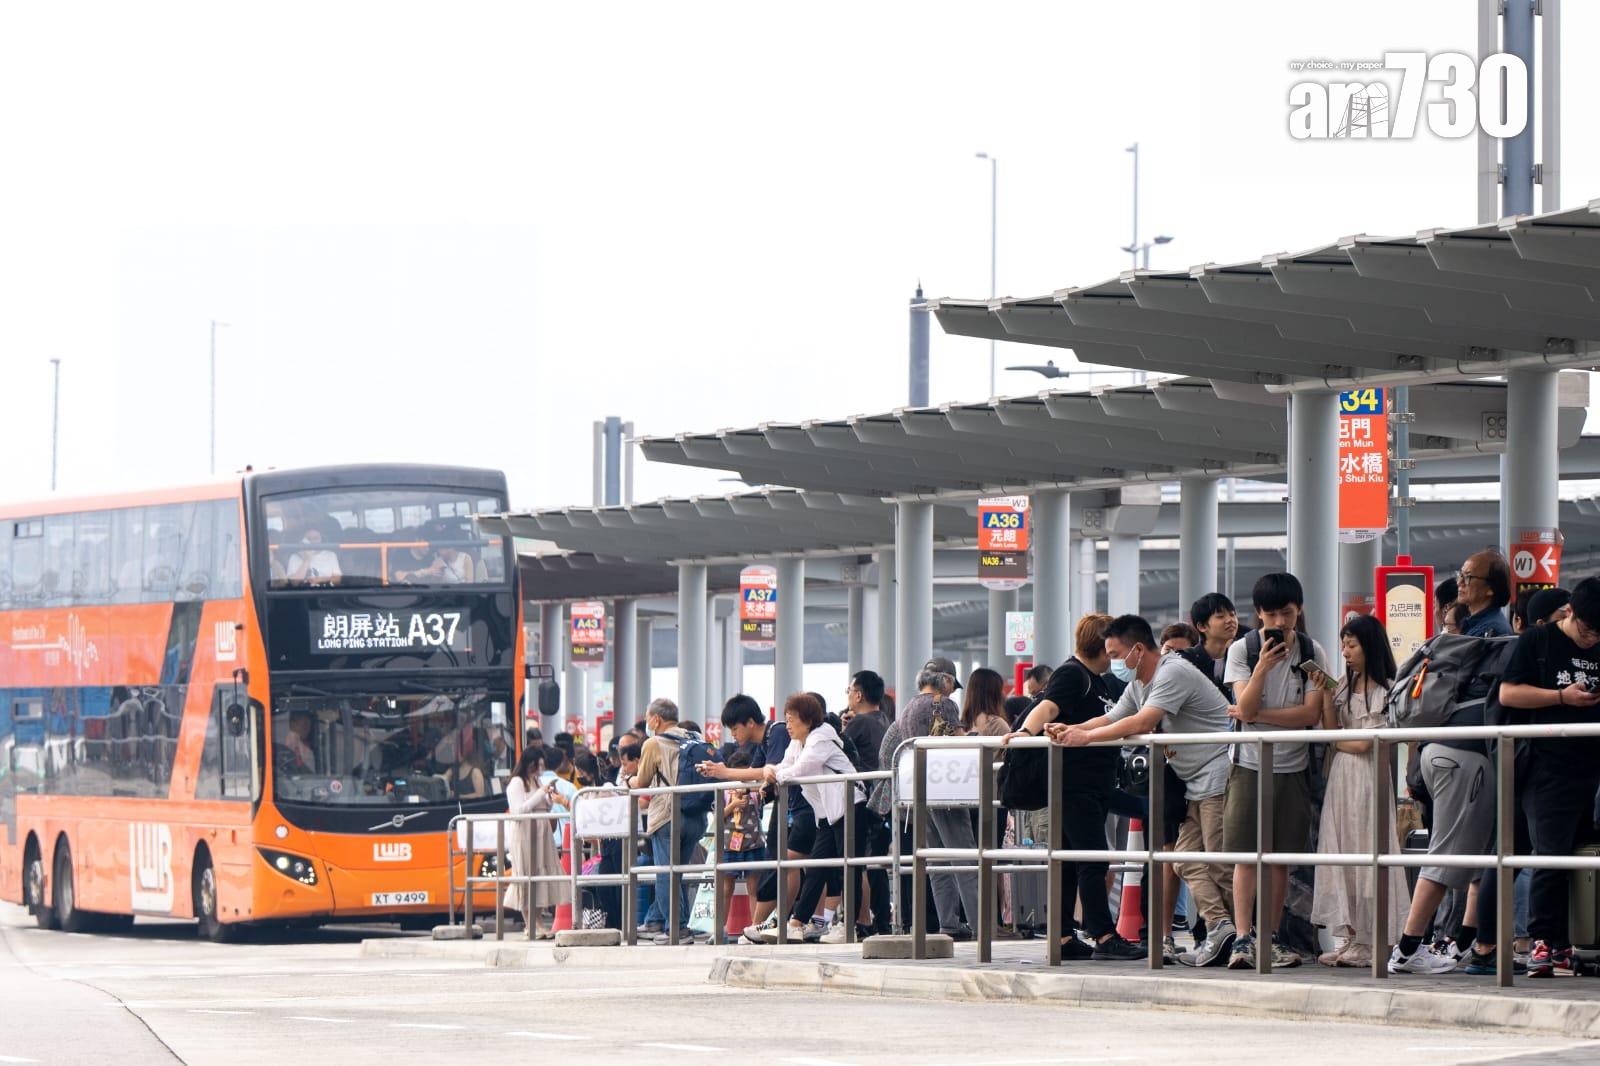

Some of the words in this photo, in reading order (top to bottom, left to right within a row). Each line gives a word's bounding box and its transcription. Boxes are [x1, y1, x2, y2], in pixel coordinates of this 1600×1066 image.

[1339, 388, 1378, 412] 34
[1339, 440, 1351, 448] en
[1353, 440, 1374, 448] Mun
[1341, 453, 1383, 474] 水橋
[1345, 474, 1366, 483] Shui
[1368, 474, 1384, 483] Kiu
[1012, 498, 1027, 508] W3
[988, 513, 1019, 528] A36
[991, 529, 1016, 542] 元朗
[982, 557, 999, 566] NA36
[1515, 557, 1533, 571] W1
[748, 589, 773, 601] A37
[323, 612, 400, 638] 朗屏站
[408, 612, 461, 646] A37
[577, 618, 598, 629] A43
[318, 637, 342, 649] LONG
[343, 637, 365, 649] PING
[367, 637, 408, 648] STATION
[373, 843, 412, 862] LWB
[129, 823, 174, 912] LWB
[375, 894, 389, 904] XT
[395, 893, 426, 902] 9499
